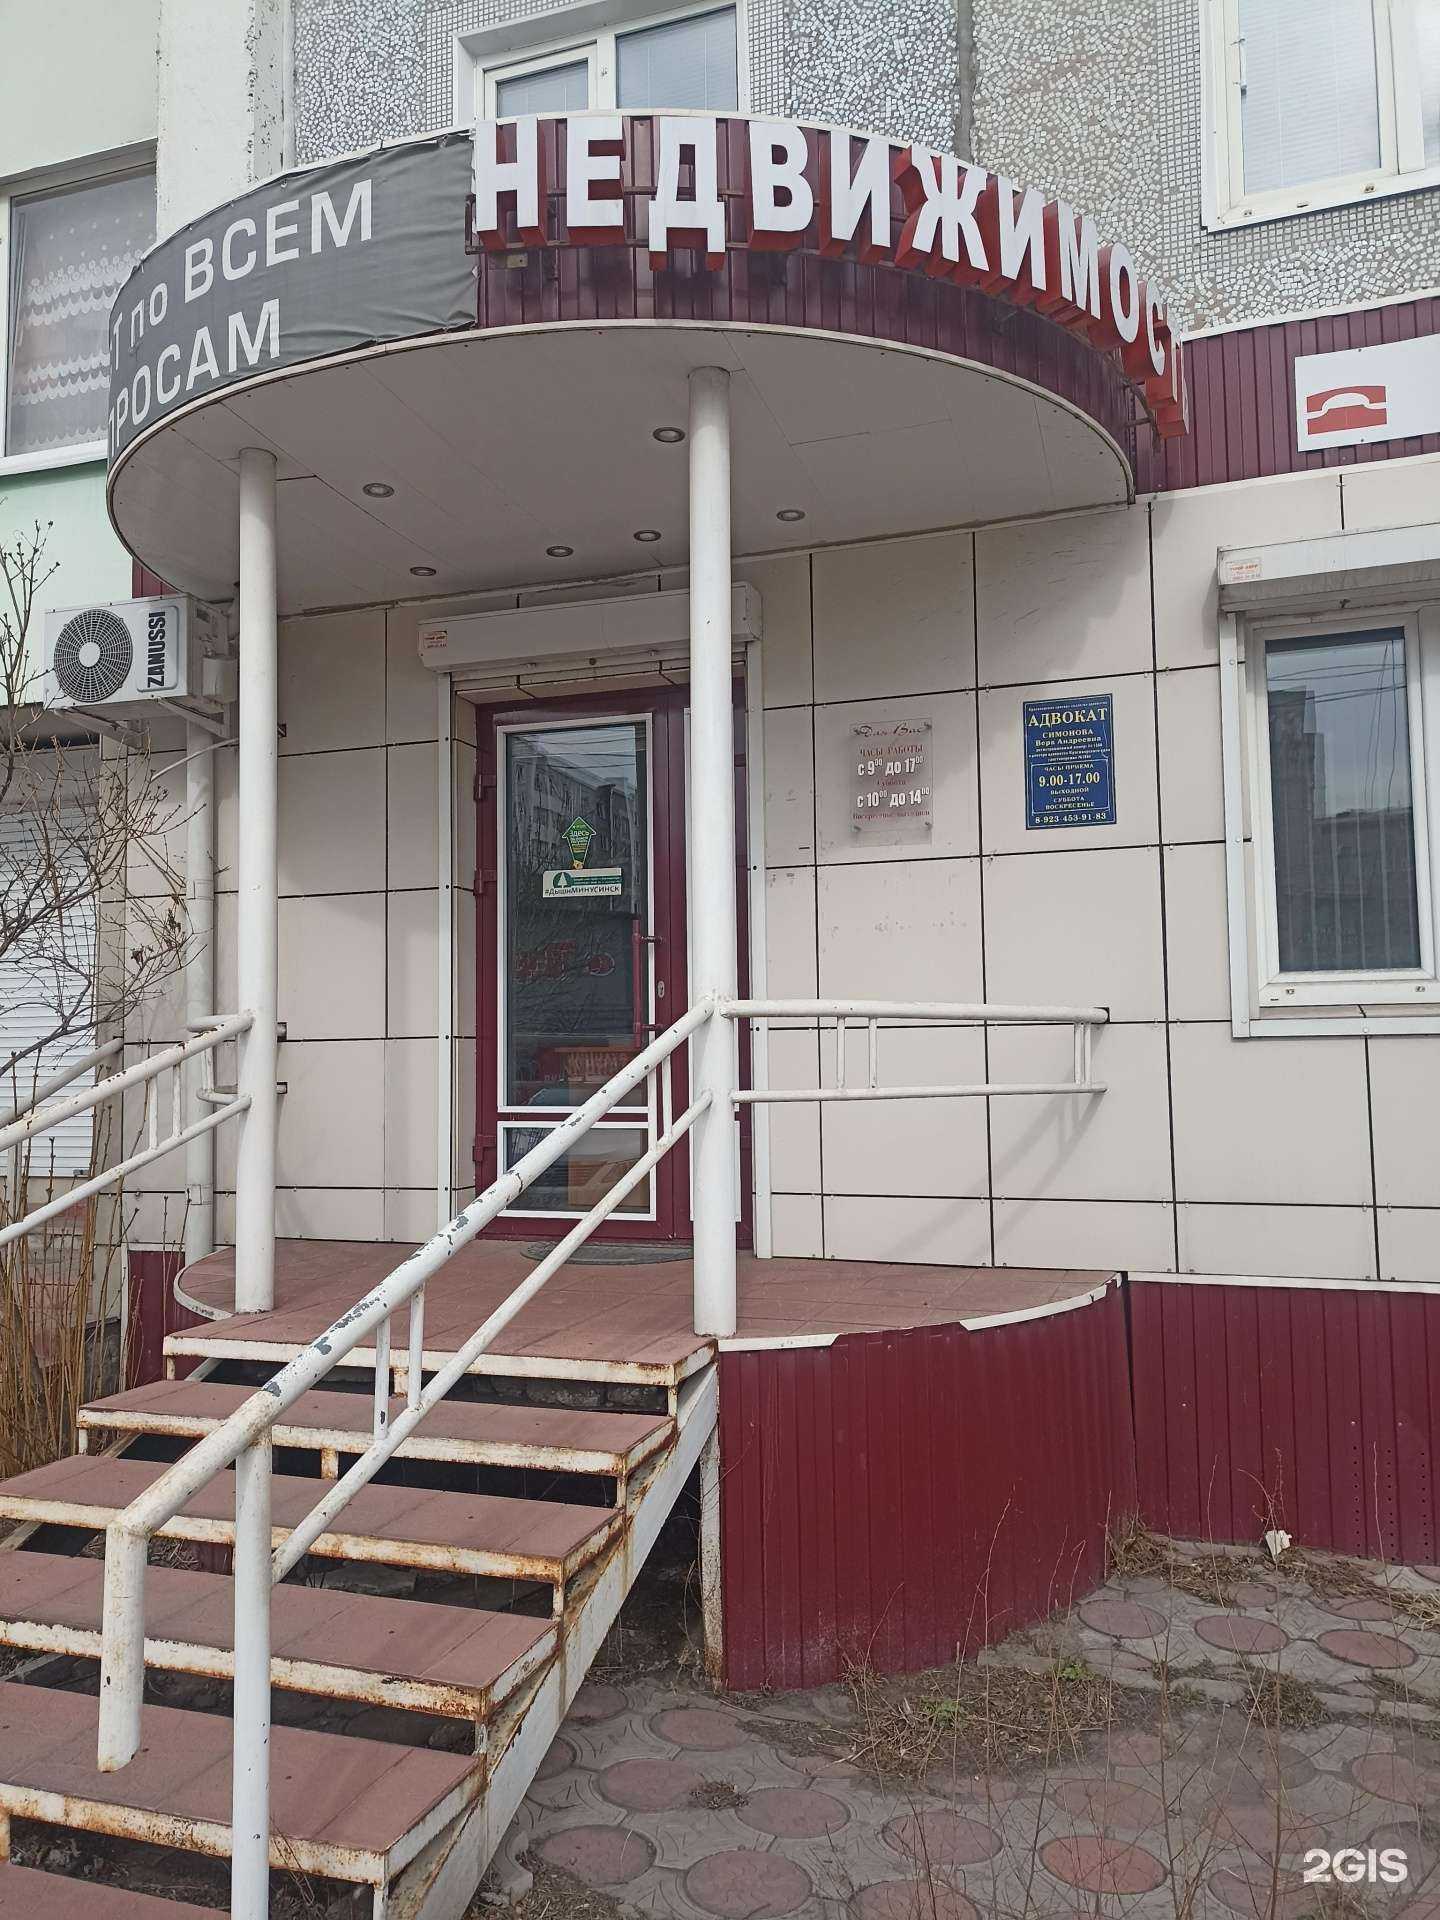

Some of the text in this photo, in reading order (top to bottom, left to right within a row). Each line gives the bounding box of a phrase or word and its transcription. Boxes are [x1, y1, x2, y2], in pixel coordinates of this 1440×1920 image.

[130, 282, 168, 348] по
[184, 179, 372, 304] ВСЕМ
[148, 611, 166, 688] ZANUSSI
[1028, 708, 1108, 729] АДВОКАТ
[1042, 728, 1094, 739] СИМОНОВА
[1035, 735, 1102, 748] Вера Андреевна
[887, 744, 923, 754] РАБОТЫ
[1044, 762, 1094, 772] ЧАСЫ ПРИЕМА
[1038, 771, 1101, 788] 9.00-17.00
[1050, 787, 1089, 796] ВЫХОДНОЙ
[1053, 796, 1085, 804] СУББОТА
[1045, 801, 1096, 811] ВОСКРЕСЕНЬЕ
